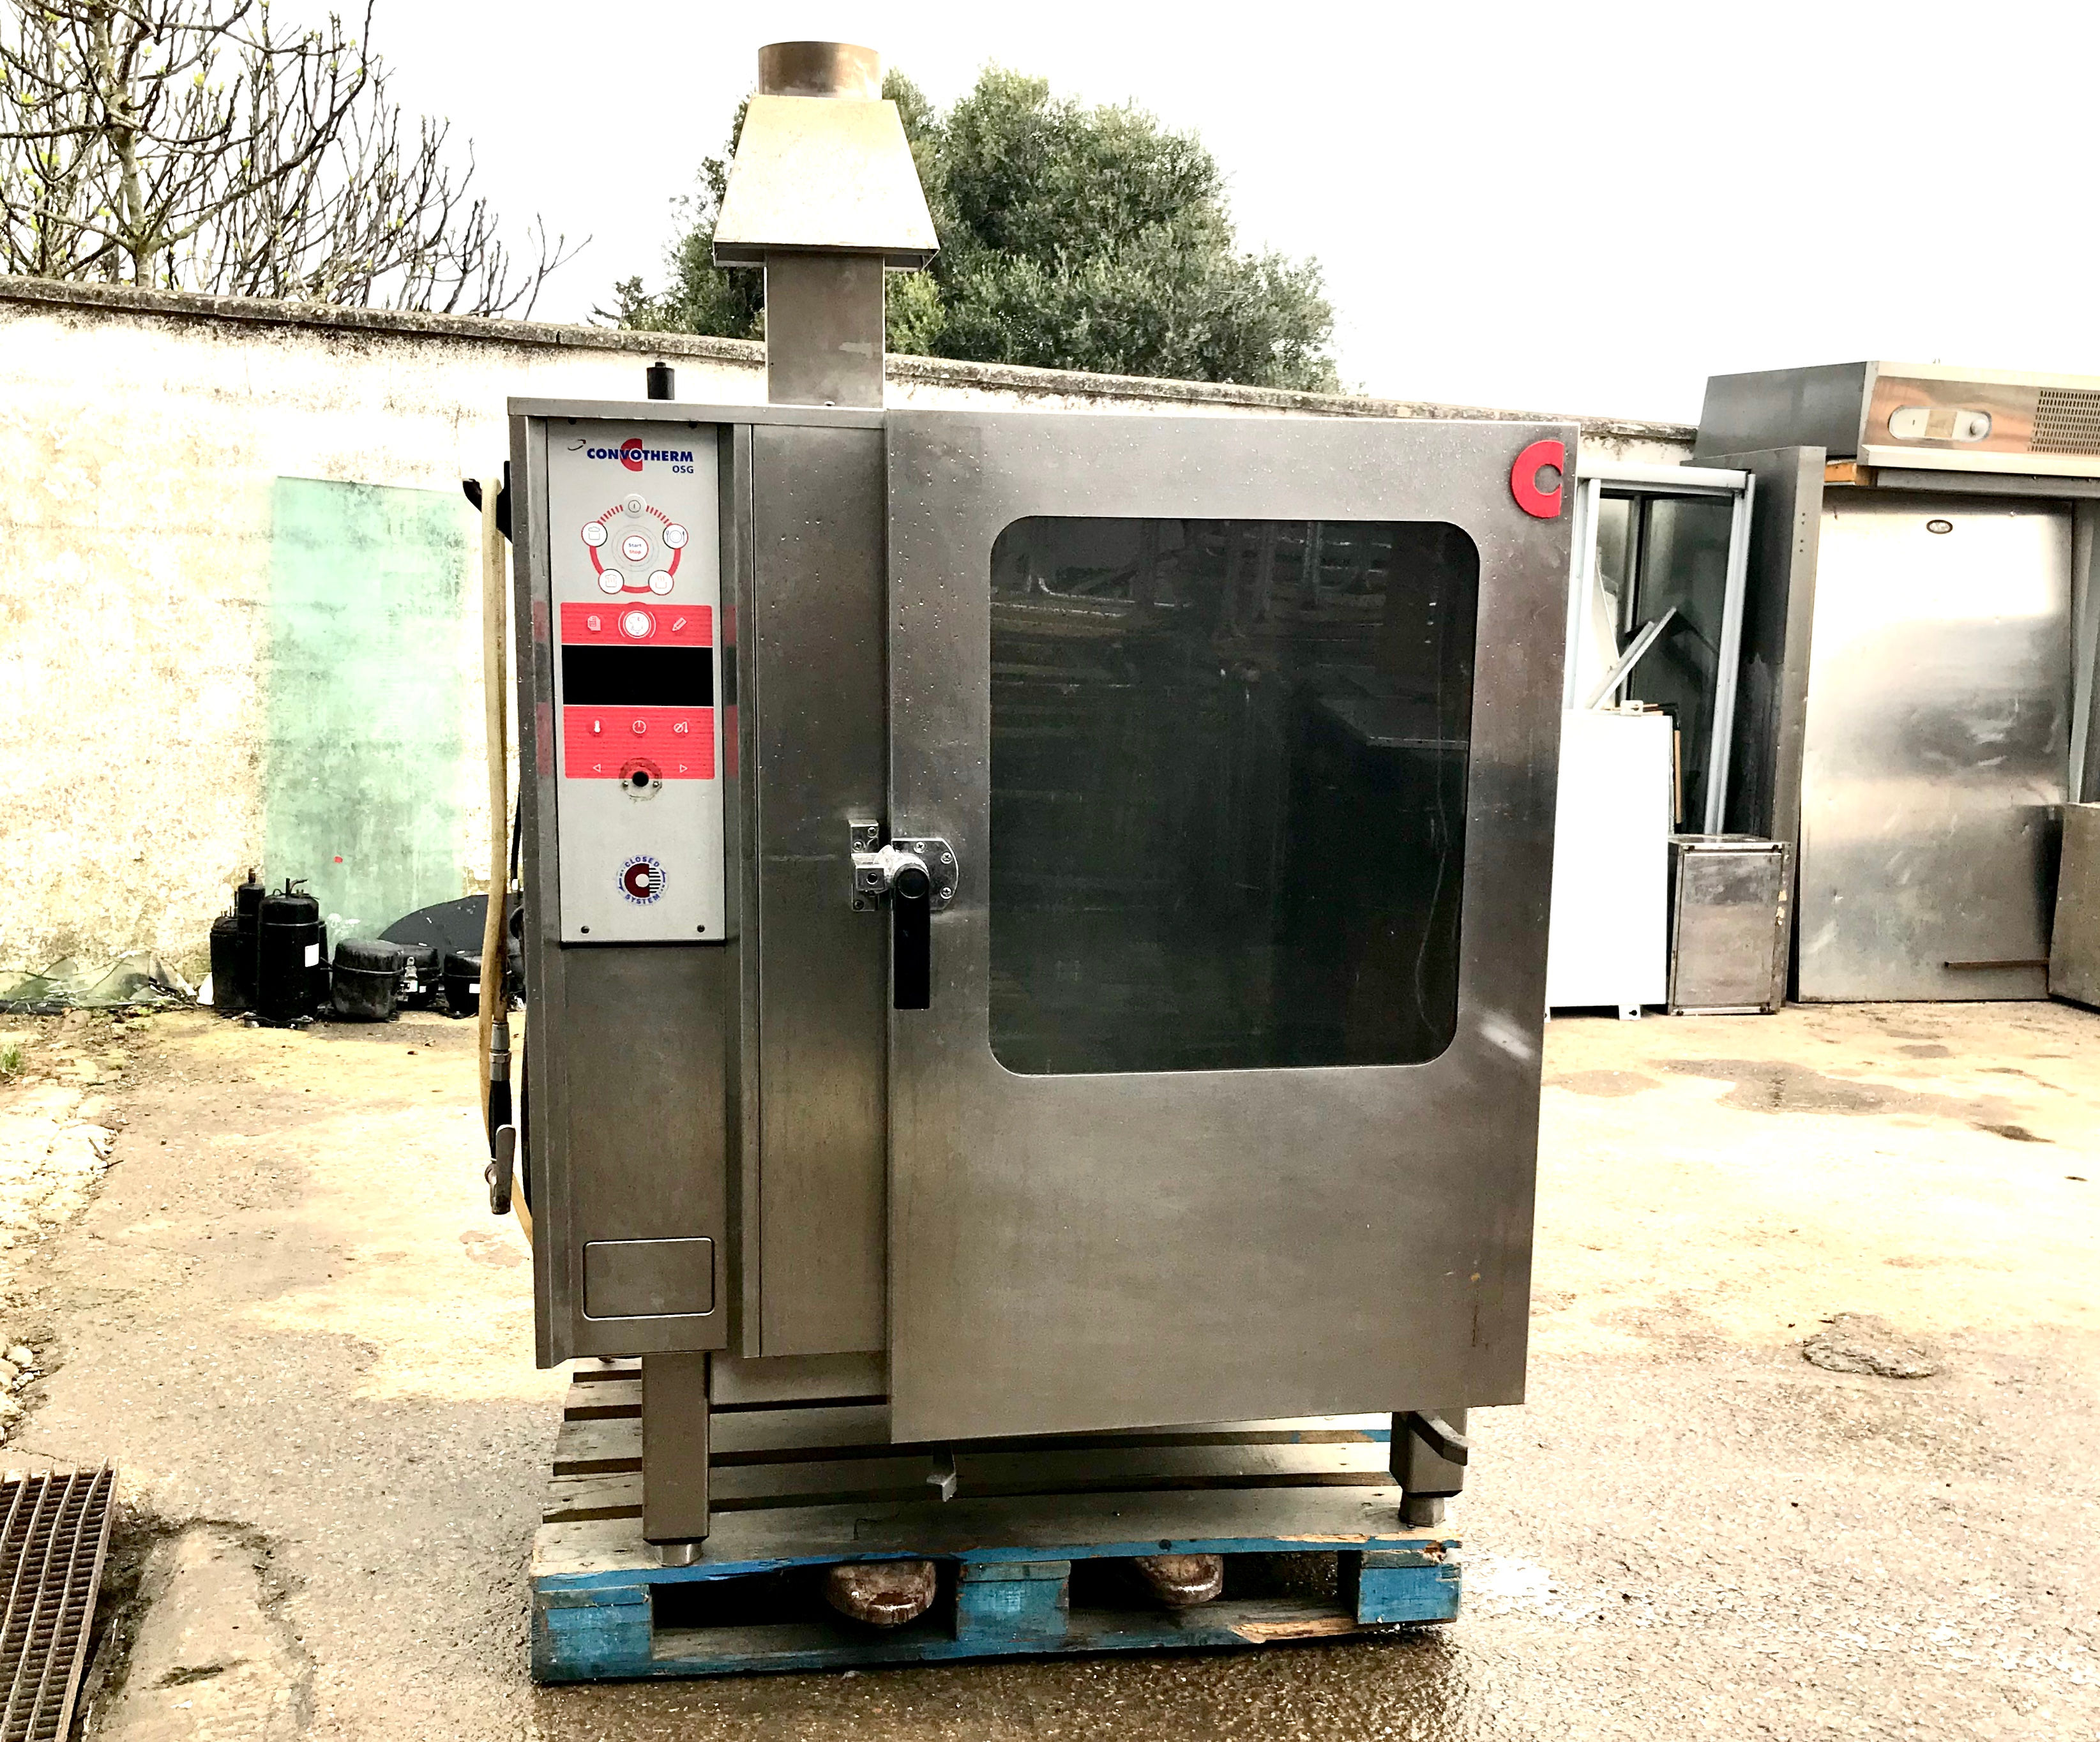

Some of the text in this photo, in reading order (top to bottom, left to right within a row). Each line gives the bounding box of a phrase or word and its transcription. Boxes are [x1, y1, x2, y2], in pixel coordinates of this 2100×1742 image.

[587, 448, 693, 462] CONVOTHERM
[672, 465, 694, 474] OSG
[624, 856, 660, 868] CLOSED
[625, 893, 660, 905] SYSTEM
